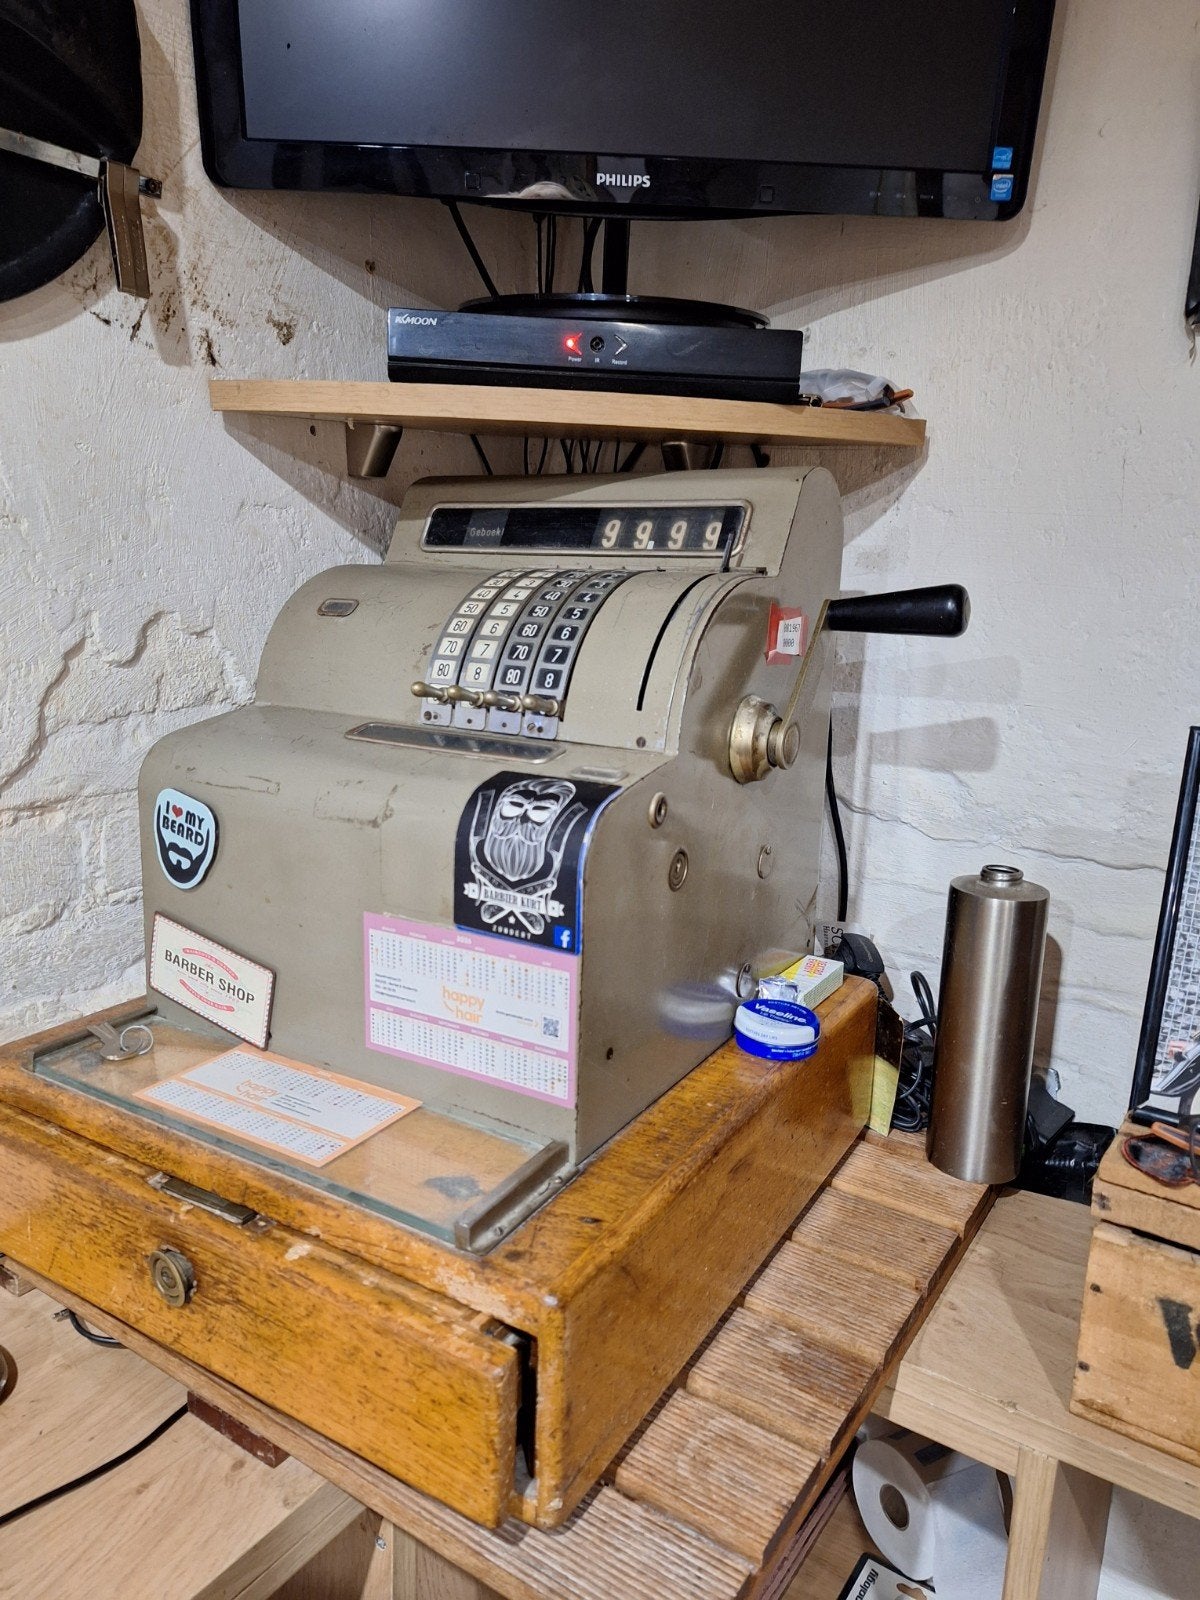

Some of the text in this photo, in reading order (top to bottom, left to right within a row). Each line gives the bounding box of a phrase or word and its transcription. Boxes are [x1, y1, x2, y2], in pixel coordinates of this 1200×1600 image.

[596, 172, 651, 188] PHILIPS
[557, 580, 573, 588] 30
[477, 589, 491, 598] 40
[544, 592, 560, 600] 40
[583, 592, 592, 602] 4
[463, 602, 583, 619] 50 5 50 5
[453, 620, 571, 639] 60 6 60 6
[445, 640, 562, 663] 70 7 70 7
[437, 663, 554, 688] 80 8 80 8
[166, 800, 205, 830] I MY
[162, 815, 204, 846] BEARD
[484, 888, 518, 906] BARBIER
[164, 949, 214, 985] BARBER
[218, 978, 255, 1004] SHOP
[442, 985, 485, 1011] happy
[456, 1005, 483, 1023] hair
[755, 1003, 807, 1023] Vaseline
[240, 1079, 280, 1097] happy
